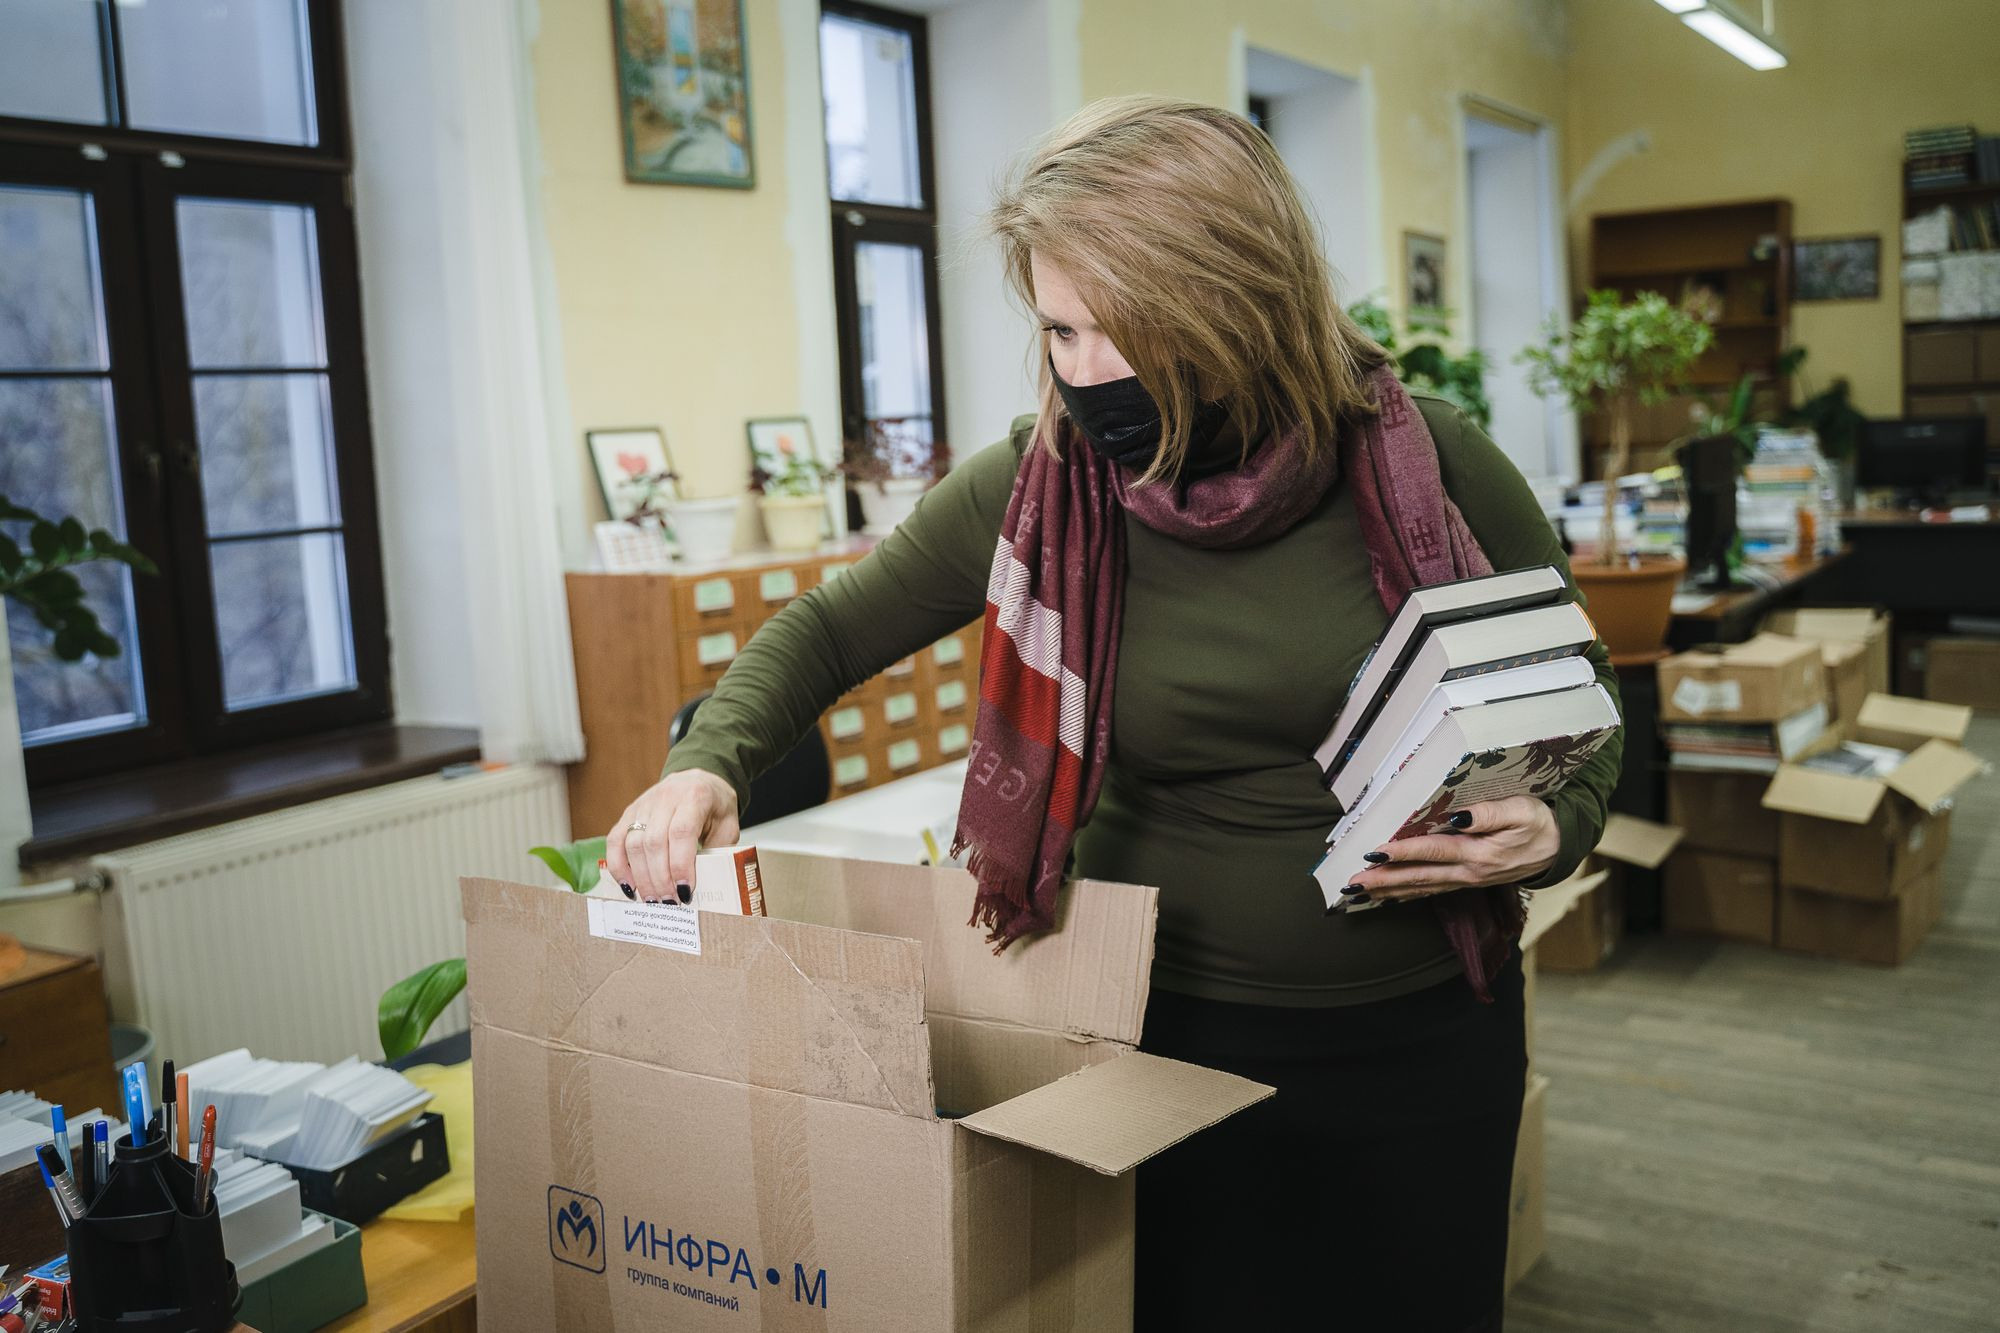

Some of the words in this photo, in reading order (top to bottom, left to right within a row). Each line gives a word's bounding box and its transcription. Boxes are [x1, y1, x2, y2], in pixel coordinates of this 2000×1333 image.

[624, 909, 649, 918] области
[649, 913, 696, 926] Нижегородской
[632, 921, 659, 930] культуры
[660, 925, 697, 936] учреждение
[614, 928, 648, 939] бюджетное
[648, 933, 697, 949] Государственное
[624, 1215, 758, 1290] ИНФРА
[627, 1267, 670, 1290] группа
[673, 1281, 740, 1312] компаний
